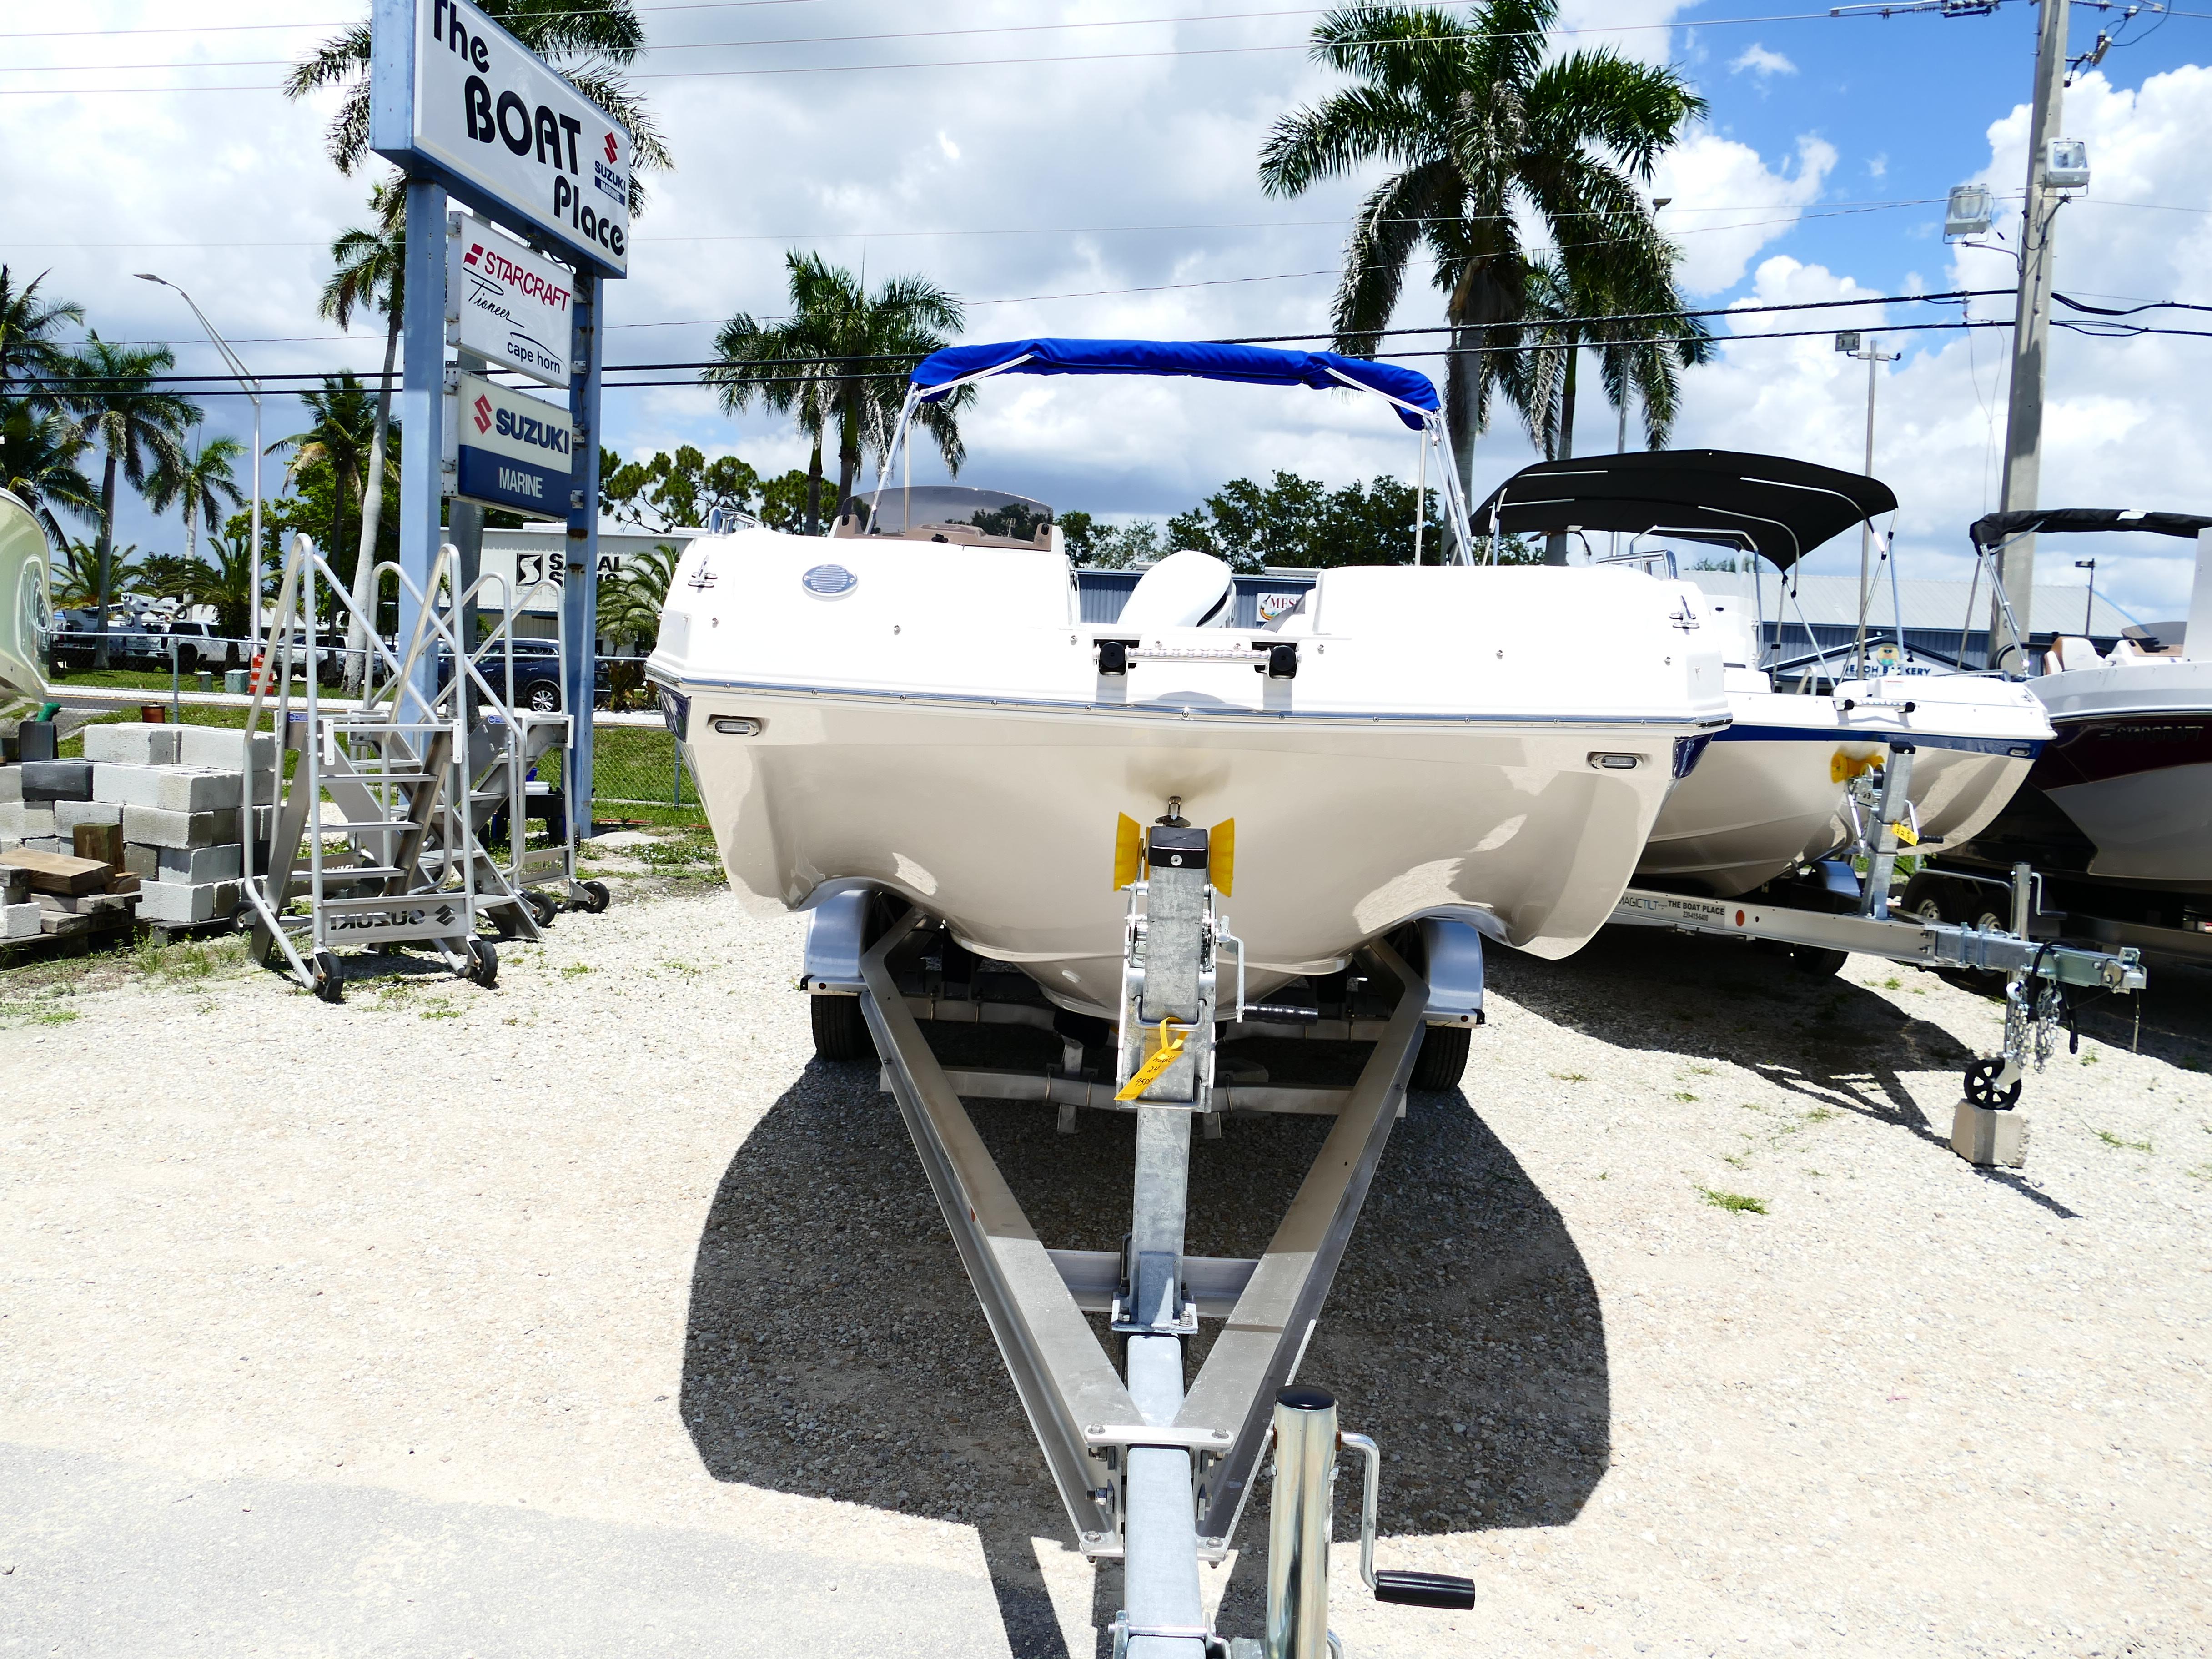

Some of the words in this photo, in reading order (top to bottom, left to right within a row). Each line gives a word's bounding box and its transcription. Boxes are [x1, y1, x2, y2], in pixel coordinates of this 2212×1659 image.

[434, 0, 490, 73] The
[464, 75, 581, 176] BOAT
[595, 160, 625, 192] SUZUKI
[601, 181, 620, 203] MARINE
[554, 175, 624, 256] Place
[463, 267, 524, 328] Pioneer
[484, 251, 570, 312] STARCRAFT
[507, 342, 533, 362] cape
[537, 351, 560, 374] horn
[496, 408, 569, 455] SUZUKI
[499, 467, 543, 498] MARINE
[1883, 666, 1930, 676] BKERY
[1668, 900, 1681, 909] THE
[1683, 902, 1700, 911] BOAT
[1702, 905, 1725, 915] PLACE
